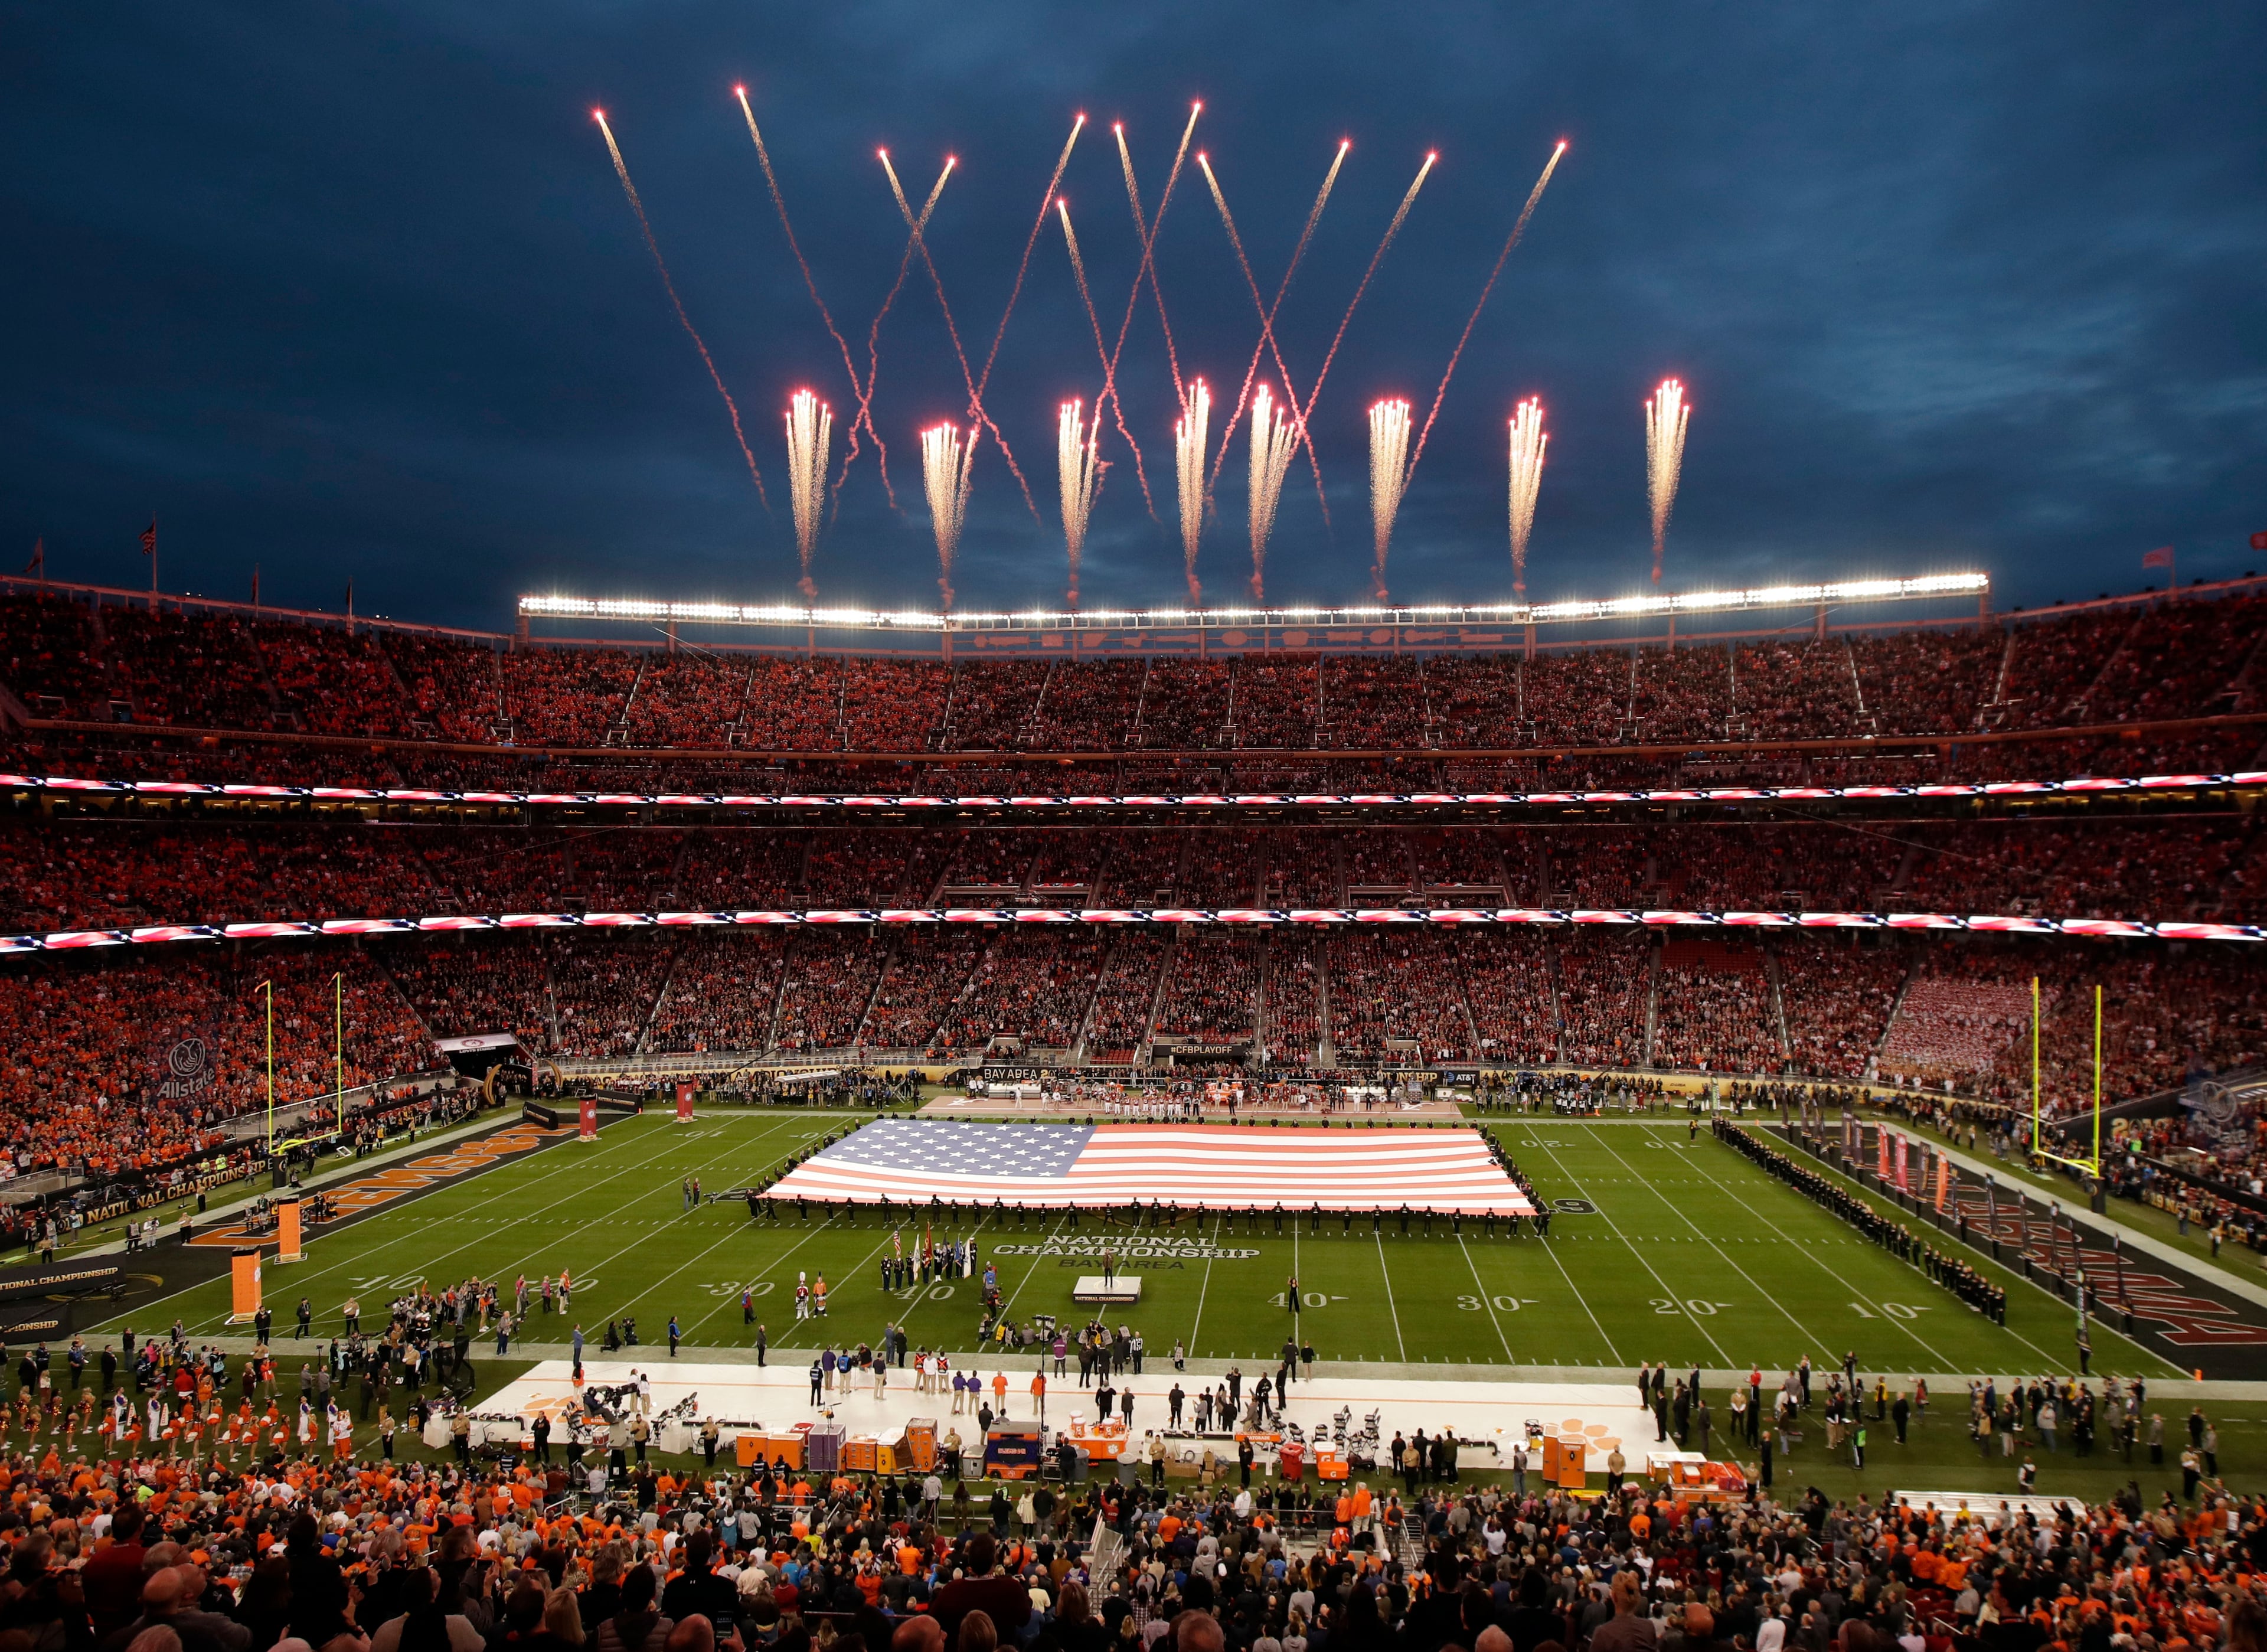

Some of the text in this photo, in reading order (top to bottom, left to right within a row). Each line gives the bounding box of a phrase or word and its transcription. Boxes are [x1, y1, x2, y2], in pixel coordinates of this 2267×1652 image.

[82, 723, 145, 733] ASSISTANCE?
[1171, 1046, 1232, 1054] #CFBPLAYOFF
[984, 1069, 1005, 1079] BAY
[1007, 1069, 1038, 1079] AREA
[156, 1067, 215, 1099] Allstate
[168, 1160, 266, 1200] CHAMPIONSIP
[1043, 1235, 1217, 1247] NATIONAL
[992, 1245, 1260, 1259] CHAMPIONSHIP
[1059, 1259, 1185, 1269] BAY AREA
[0, 1266, 119, 1291] TIONAL CHAMPIONSHIP
[352, 1275, 425, 1289] 10
[710, 1281, 775, 1297] 30
[894, 1285, 955, 1300] 40
[1267, 1292, 1327, 1308] 40
[1457, 1295, 1520, 1312] 30
[1648, 1298, 1717, 1315] 20
[1847, 1302, 1918, 1319] 10
[4, 1320, 59, 1333] IONSHIP
[395, 1376, 404, 1385] 20
